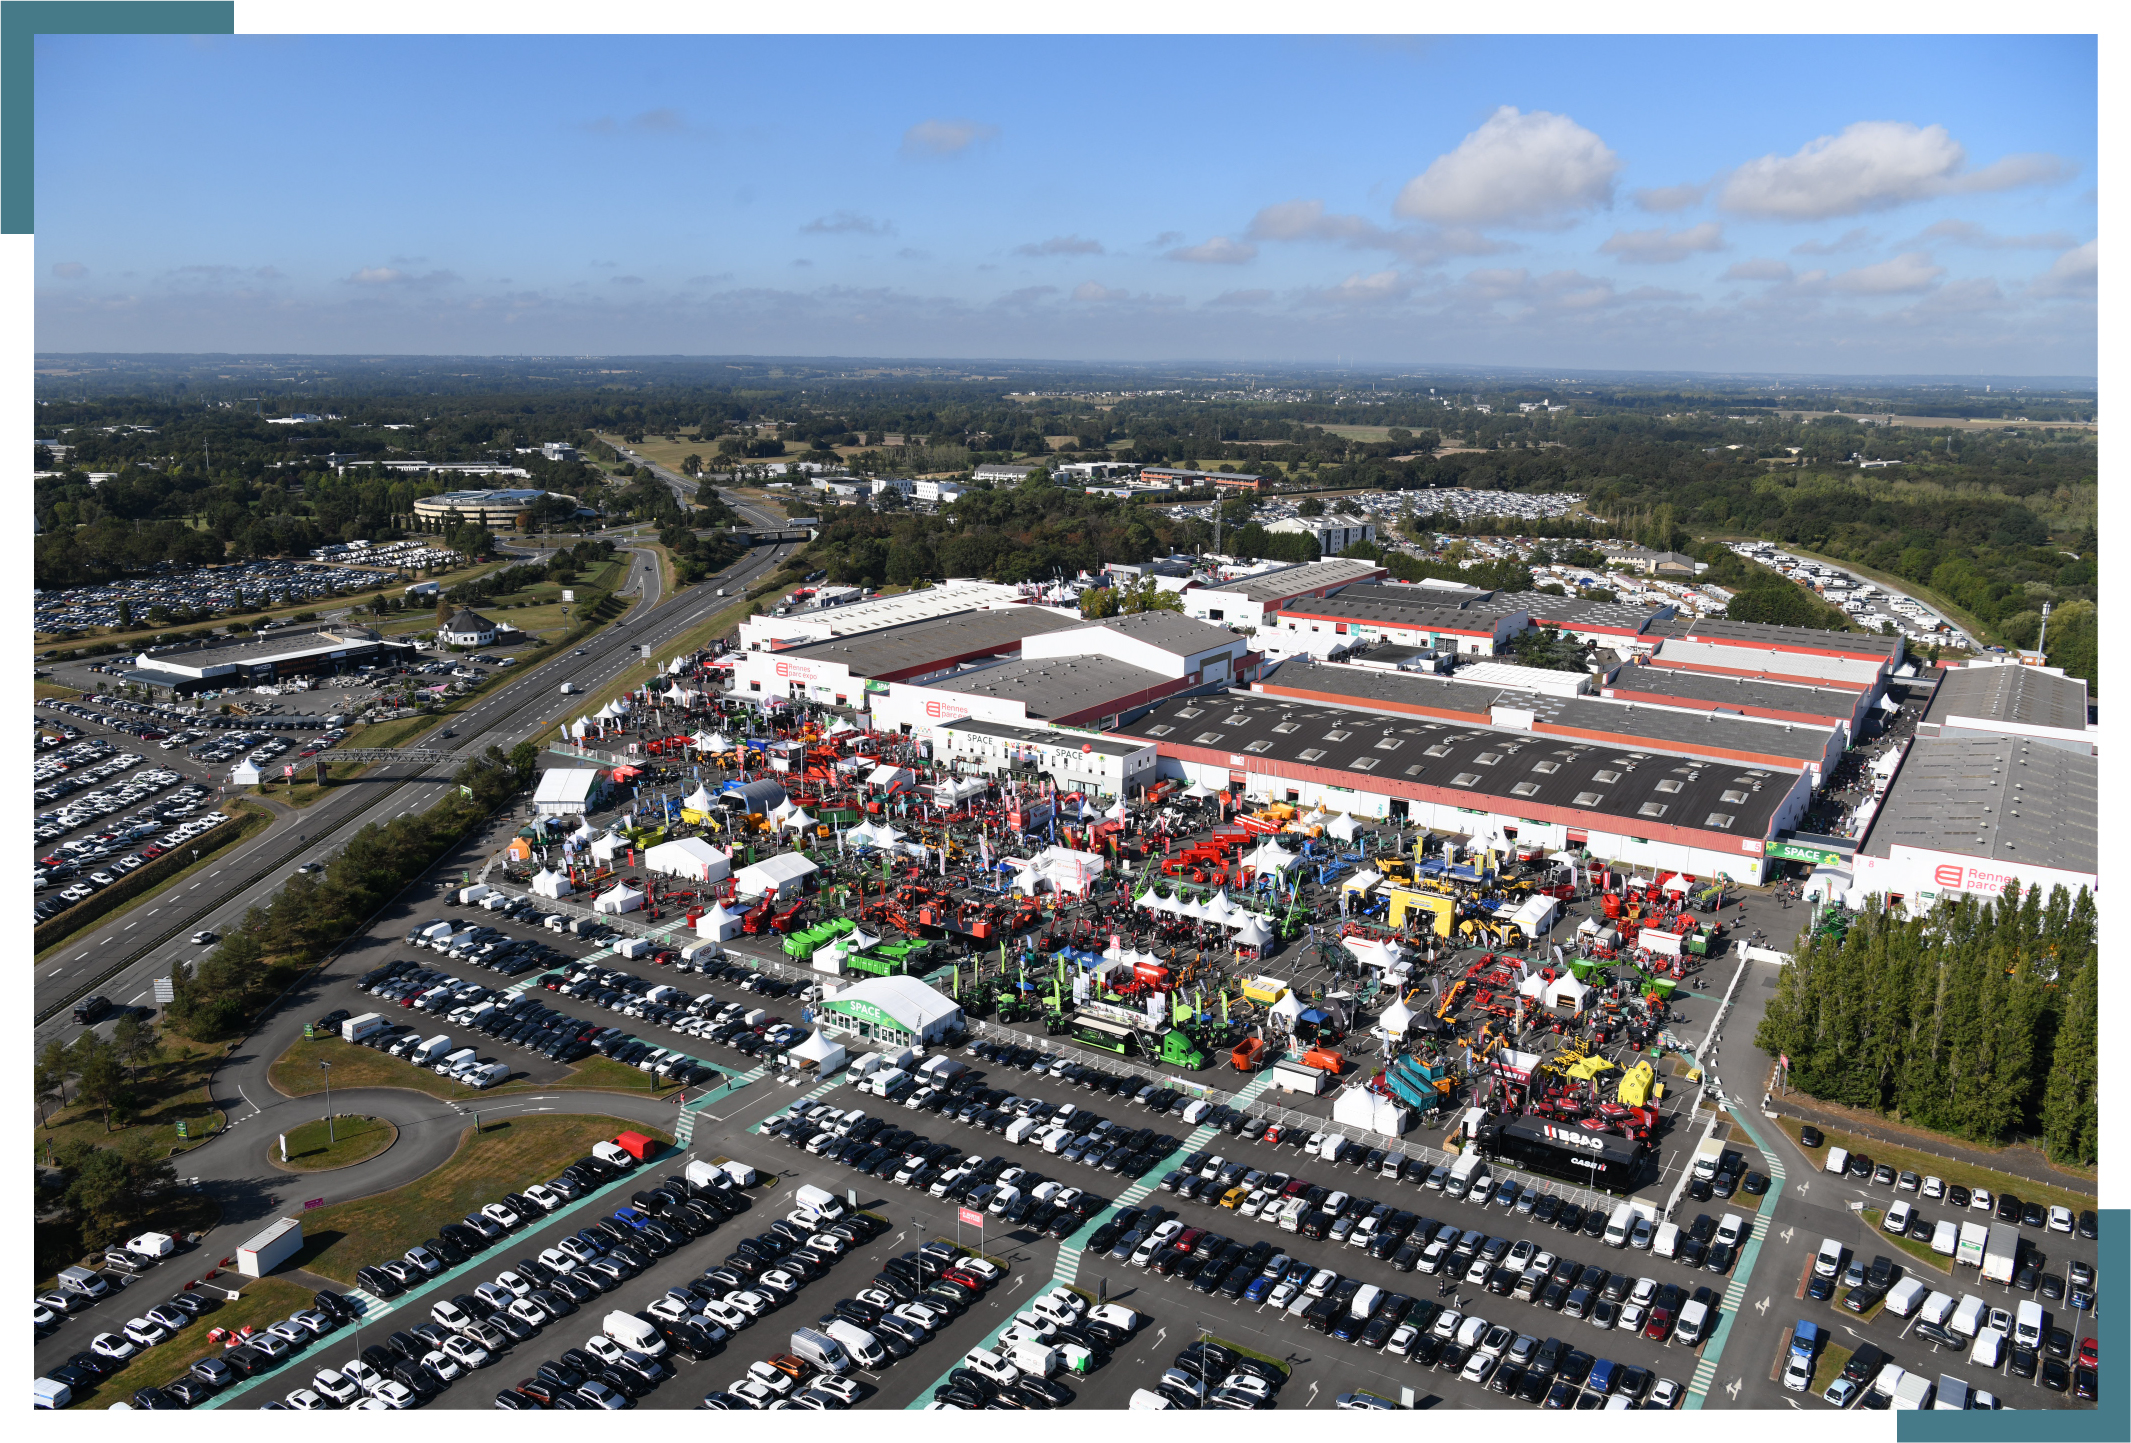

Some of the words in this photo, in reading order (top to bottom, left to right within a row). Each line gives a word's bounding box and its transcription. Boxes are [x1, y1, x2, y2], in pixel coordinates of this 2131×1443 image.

[788, 663, 810, 672] Rennes
[942, 702, 968, 713] Rennes
[967, 734, 993, 745] SPACE
[1056, 749, 1083, 760] SPACE
[1784, 847, 1820, 860] SPACE
[1969, 868, 2016, 884] Renne
[1967, 880, 1996, 892] parc
[1112, 936, 1118, 946] A
[850, 1000, 880, 1019] SPACE
[1571, 1158, 1598, 1169] CASE
